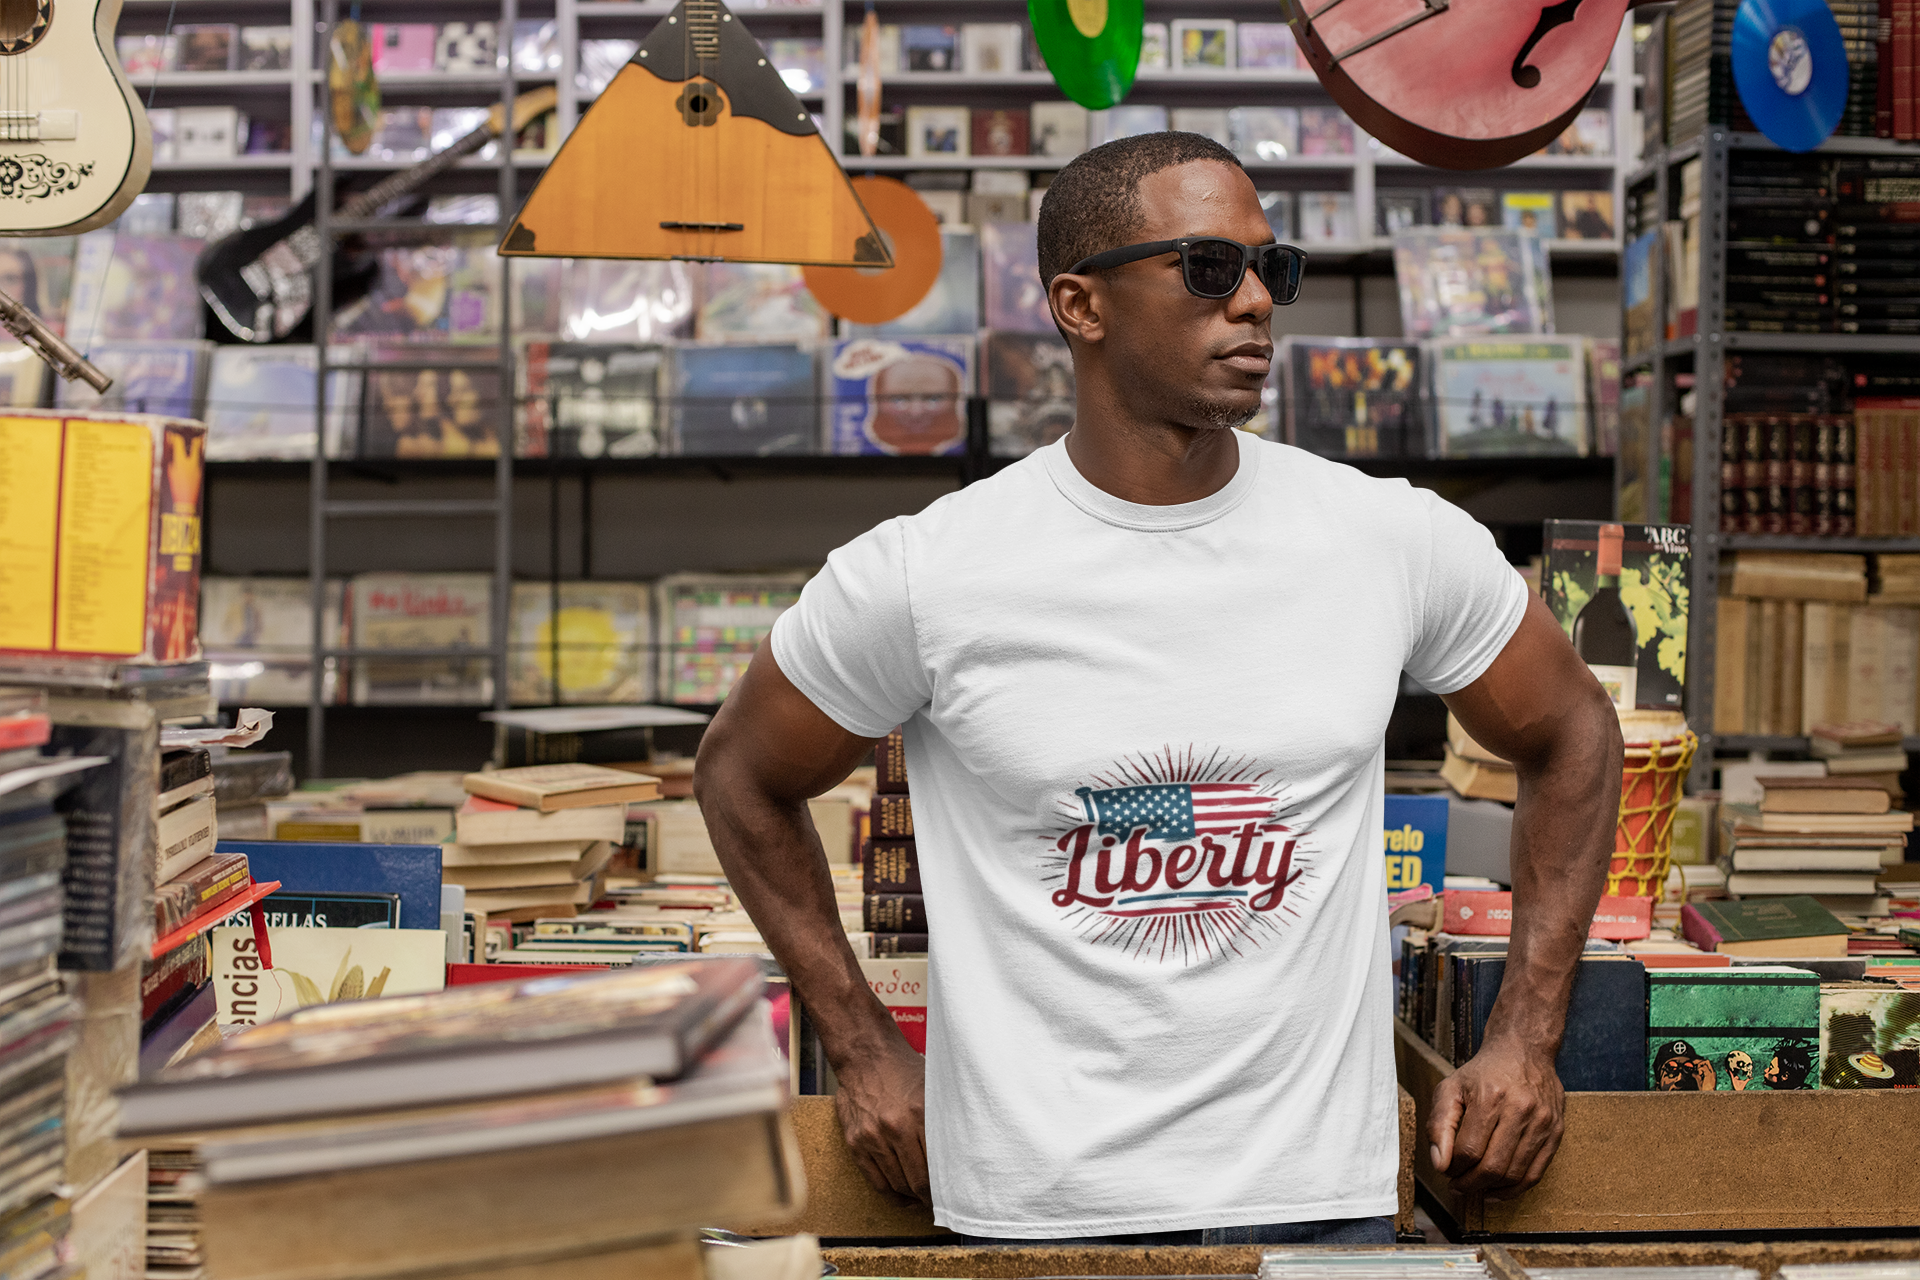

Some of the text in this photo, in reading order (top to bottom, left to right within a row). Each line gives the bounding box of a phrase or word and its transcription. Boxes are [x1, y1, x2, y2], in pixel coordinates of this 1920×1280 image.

[880, 797, 890, 835] AMADO
[873, 846, 882, 884] AMADO
[1051, 821, 1304, 912] Liberty
[1385, 855, 1423, 889] ED
